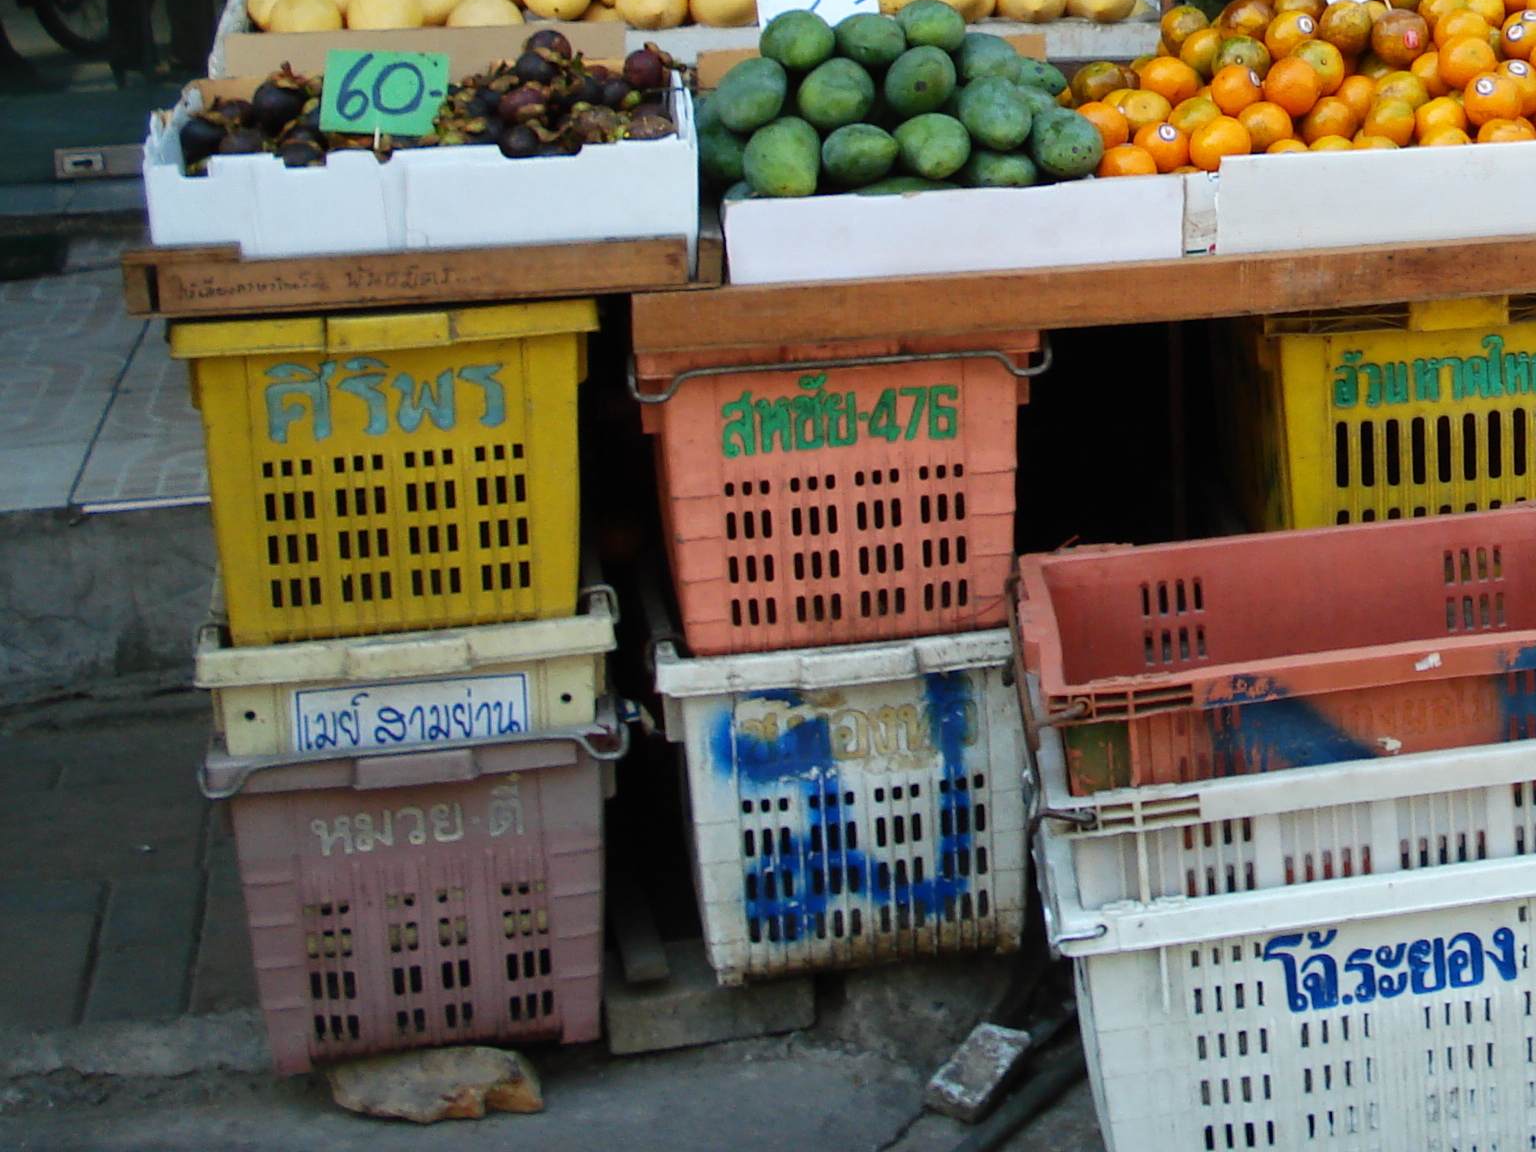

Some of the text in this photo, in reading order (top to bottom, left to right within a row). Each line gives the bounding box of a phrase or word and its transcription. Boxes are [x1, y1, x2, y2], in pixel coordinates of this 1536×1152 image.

[264, 356, 506, 444] ศิริพร
[721, 373, 959, 459] สหชัย-476
[304, 689, 520, 751] เมย์ สามย่าน
